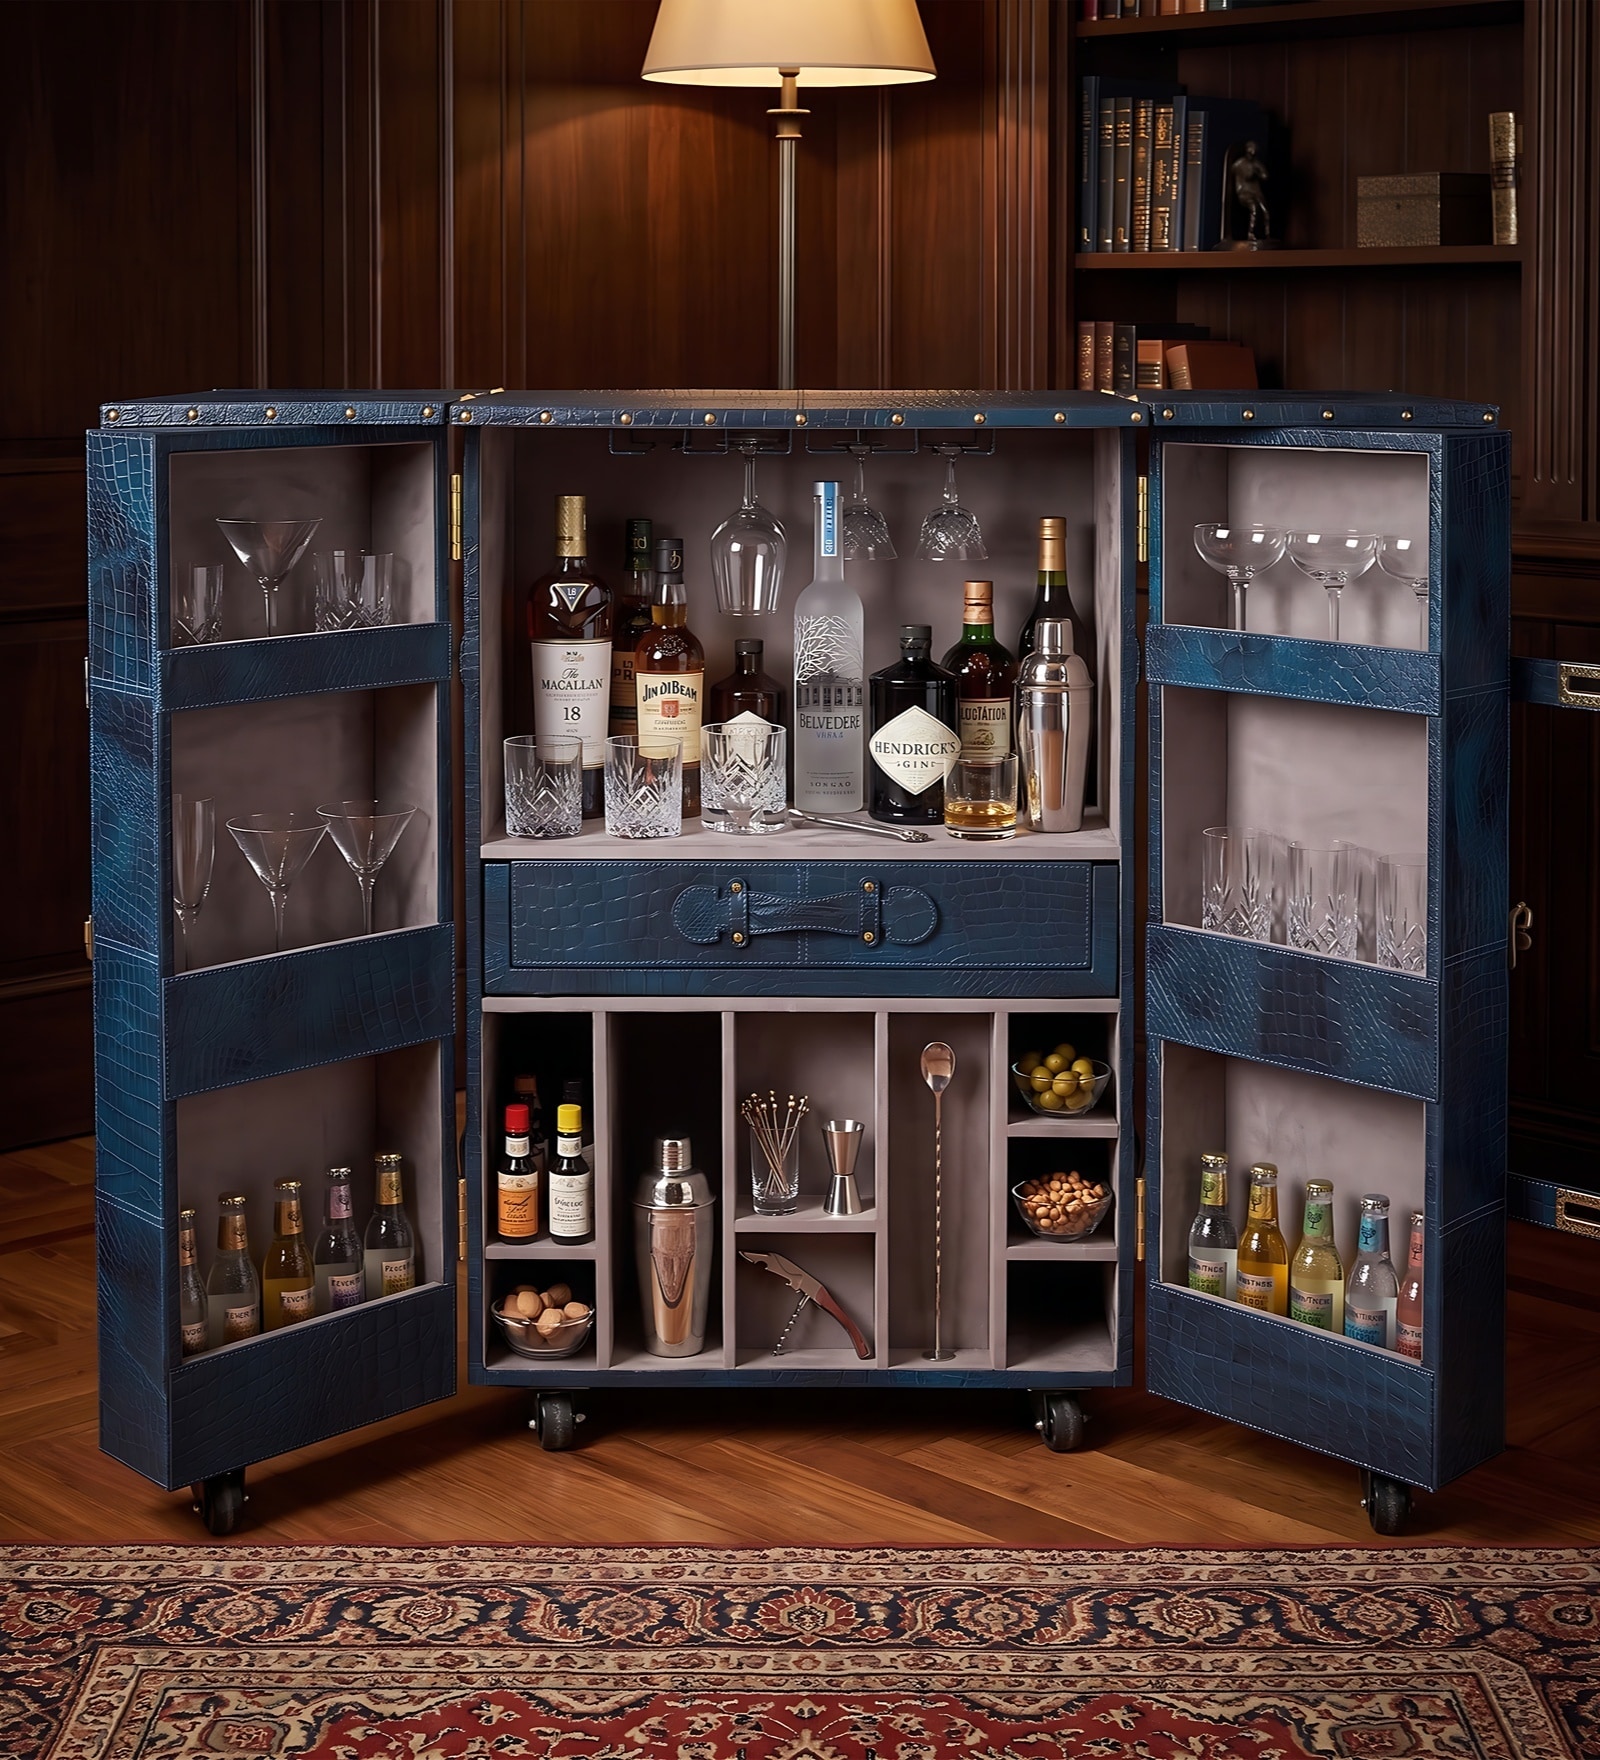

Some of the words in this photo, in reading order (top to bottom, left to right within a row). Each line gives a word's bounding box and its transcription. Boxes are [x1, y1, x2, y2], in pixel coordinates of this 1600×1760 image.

[561, 668, 580, 680] The
[541, 678, 604, 691] MACALLAN
[563, 706, 582, 721] 18
[799, 712, 861, 730] BELVEDERE
[874, 741, 957, 756] HENDRICK'S
[902, 760, 929, 769] GIN
